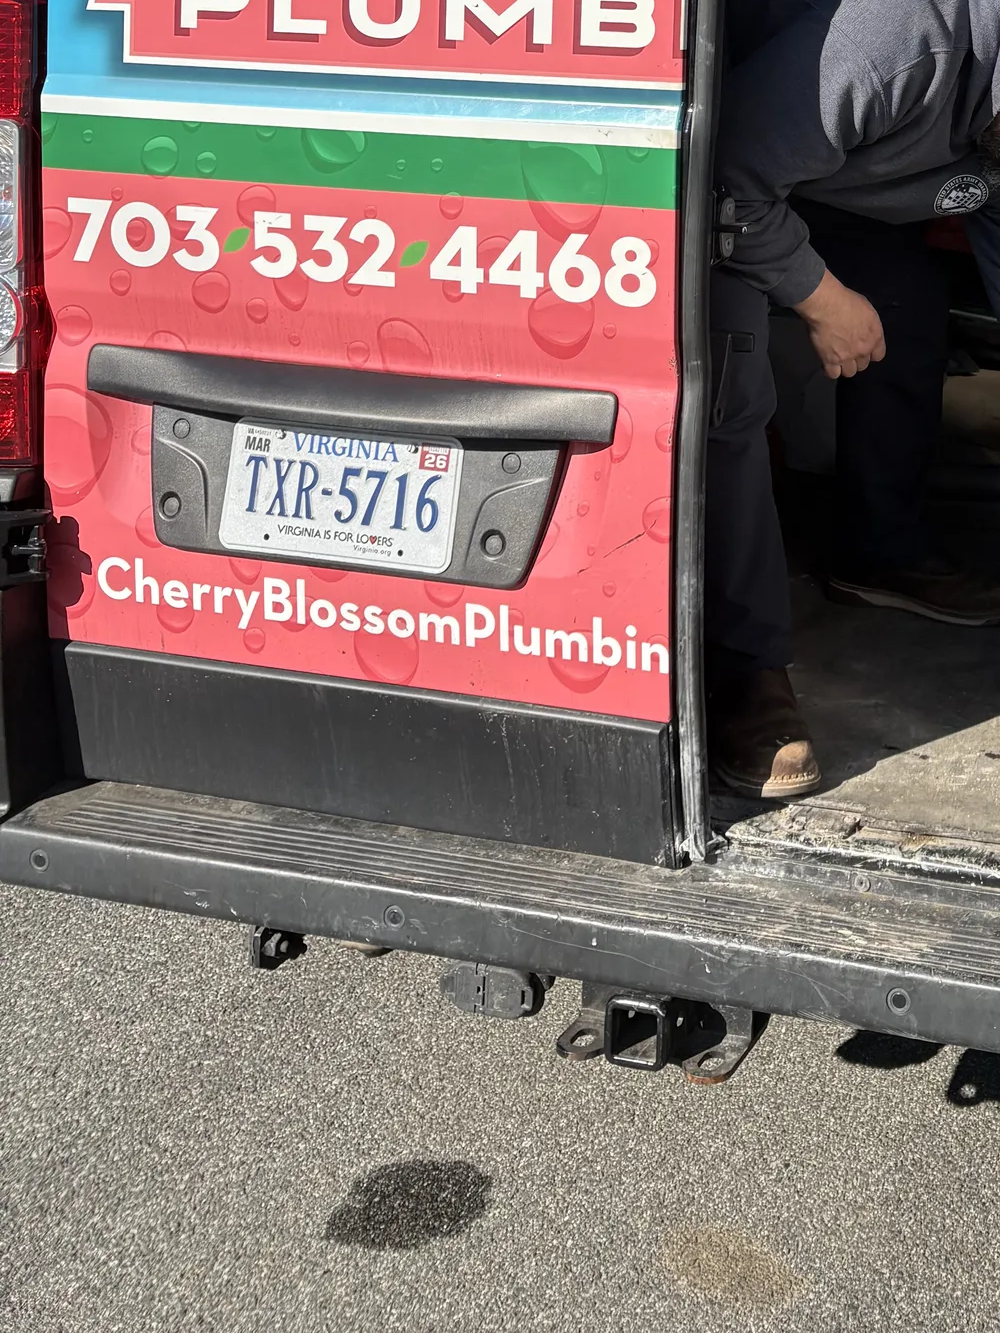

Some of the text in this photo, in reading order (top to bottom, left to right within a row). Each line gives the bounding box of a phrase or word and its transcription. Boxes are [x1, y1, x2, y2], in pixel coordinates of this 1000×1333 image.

[66, 197, 658, 308] 703 532 4468
[244, 435, 271, 453] MAR
[292, 431, 400, 463] VIRGINIA
[424, 453, 448, 470] 26
[245, 455, 442, 533] TXR-5716
[277, 524, 322, 539] VIRGINIA
[323, 529, 332, 540] IS
[334, 531, 354, 543] FOR
[352, 544, 392, 557] Virginia.org
[97, 556, 669, 674] CherryBlossomPlumbin
